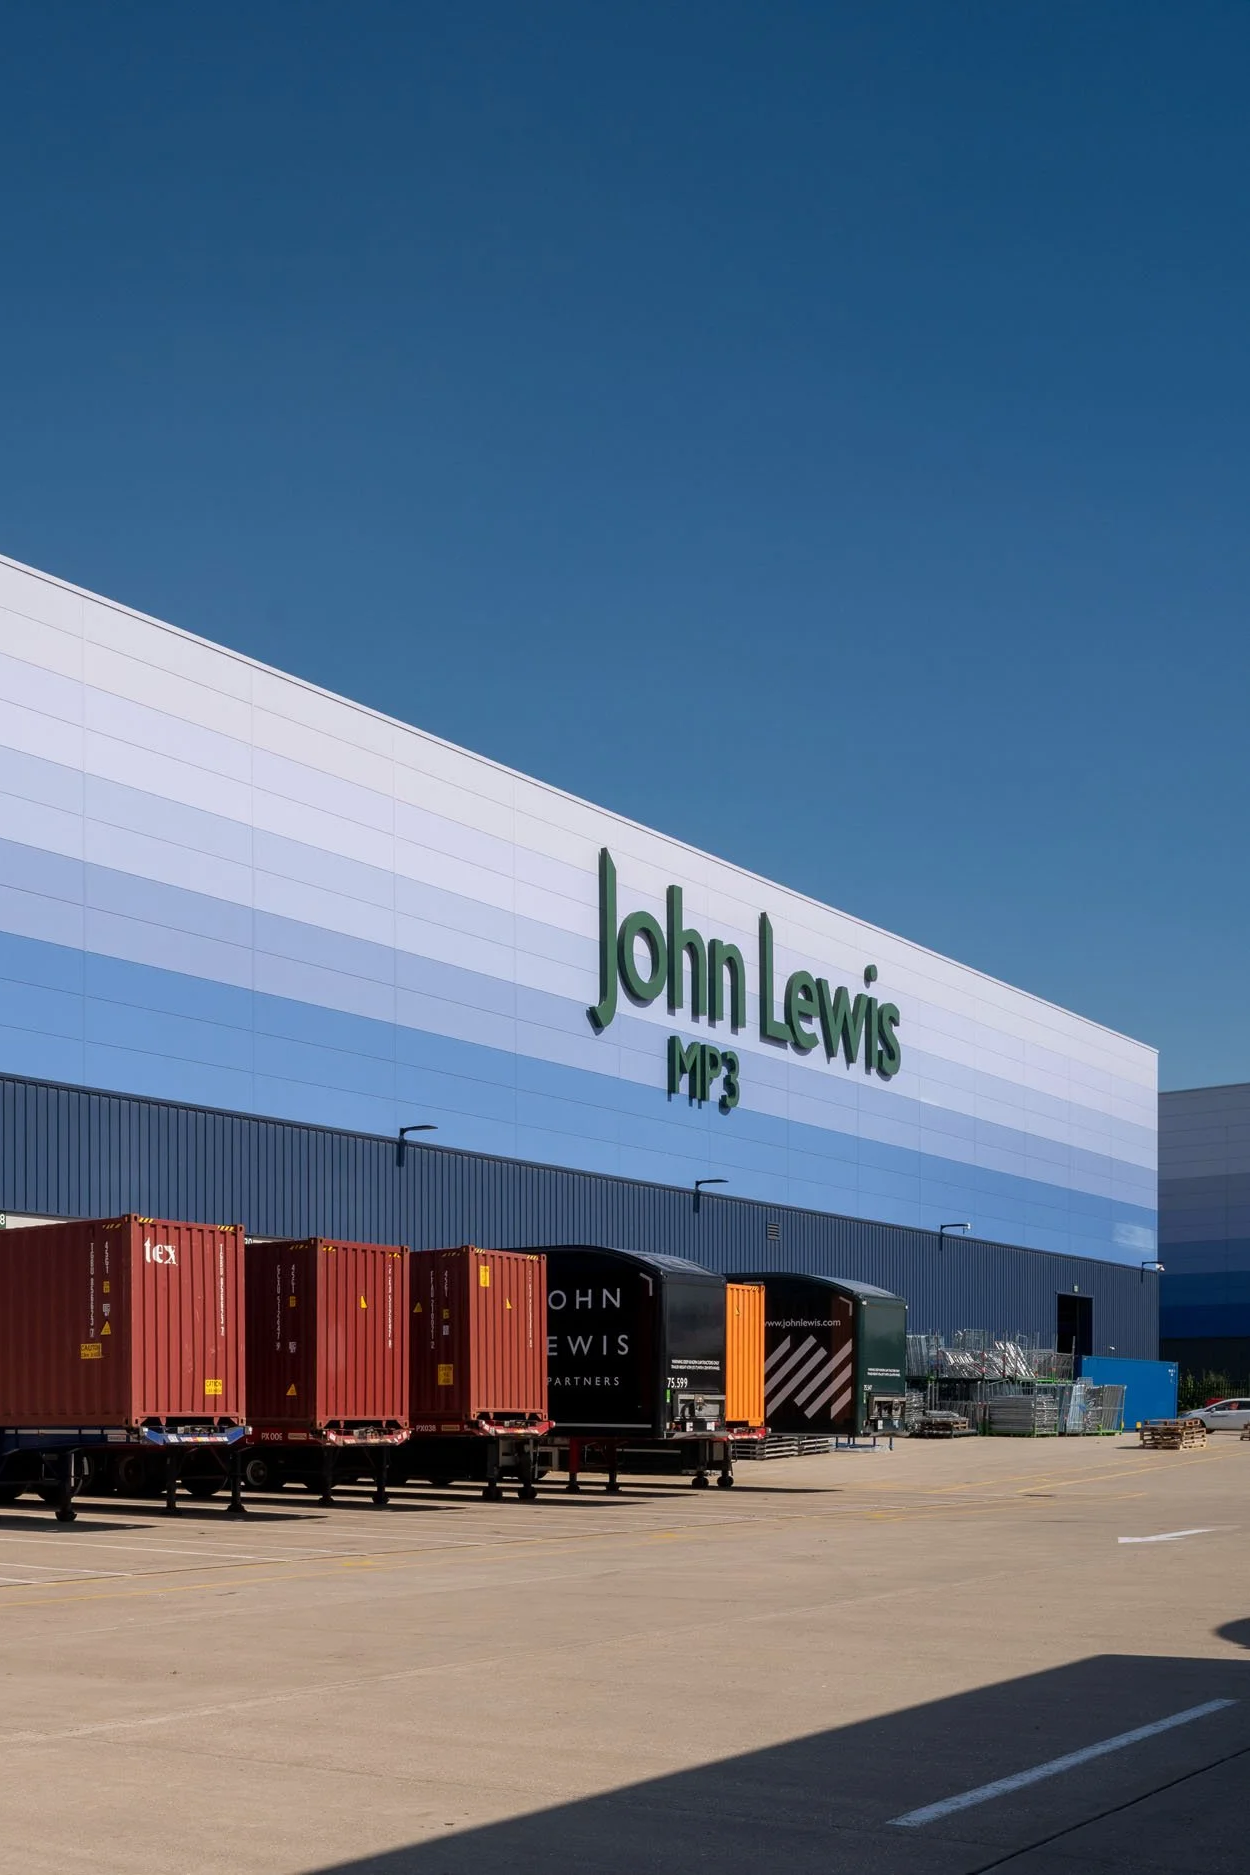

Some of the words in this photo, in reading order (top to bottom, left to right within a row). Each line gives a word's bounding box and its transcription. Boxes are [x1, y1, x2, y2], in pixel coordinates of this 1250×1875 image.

[587, 847, 746, 1029] John
[759, 911, 901, 1077] Lewis
[667, 1035, 740, 1109] MP3
[144, 1237, 177, 1265] tex
[548, 1288, 620, 1310] OHN
[547, 1334, 629, 1356] EWIS
[547, 1376, 620, 1386] PARTNERS
[667, 1377, 688, 1388] 75.599
